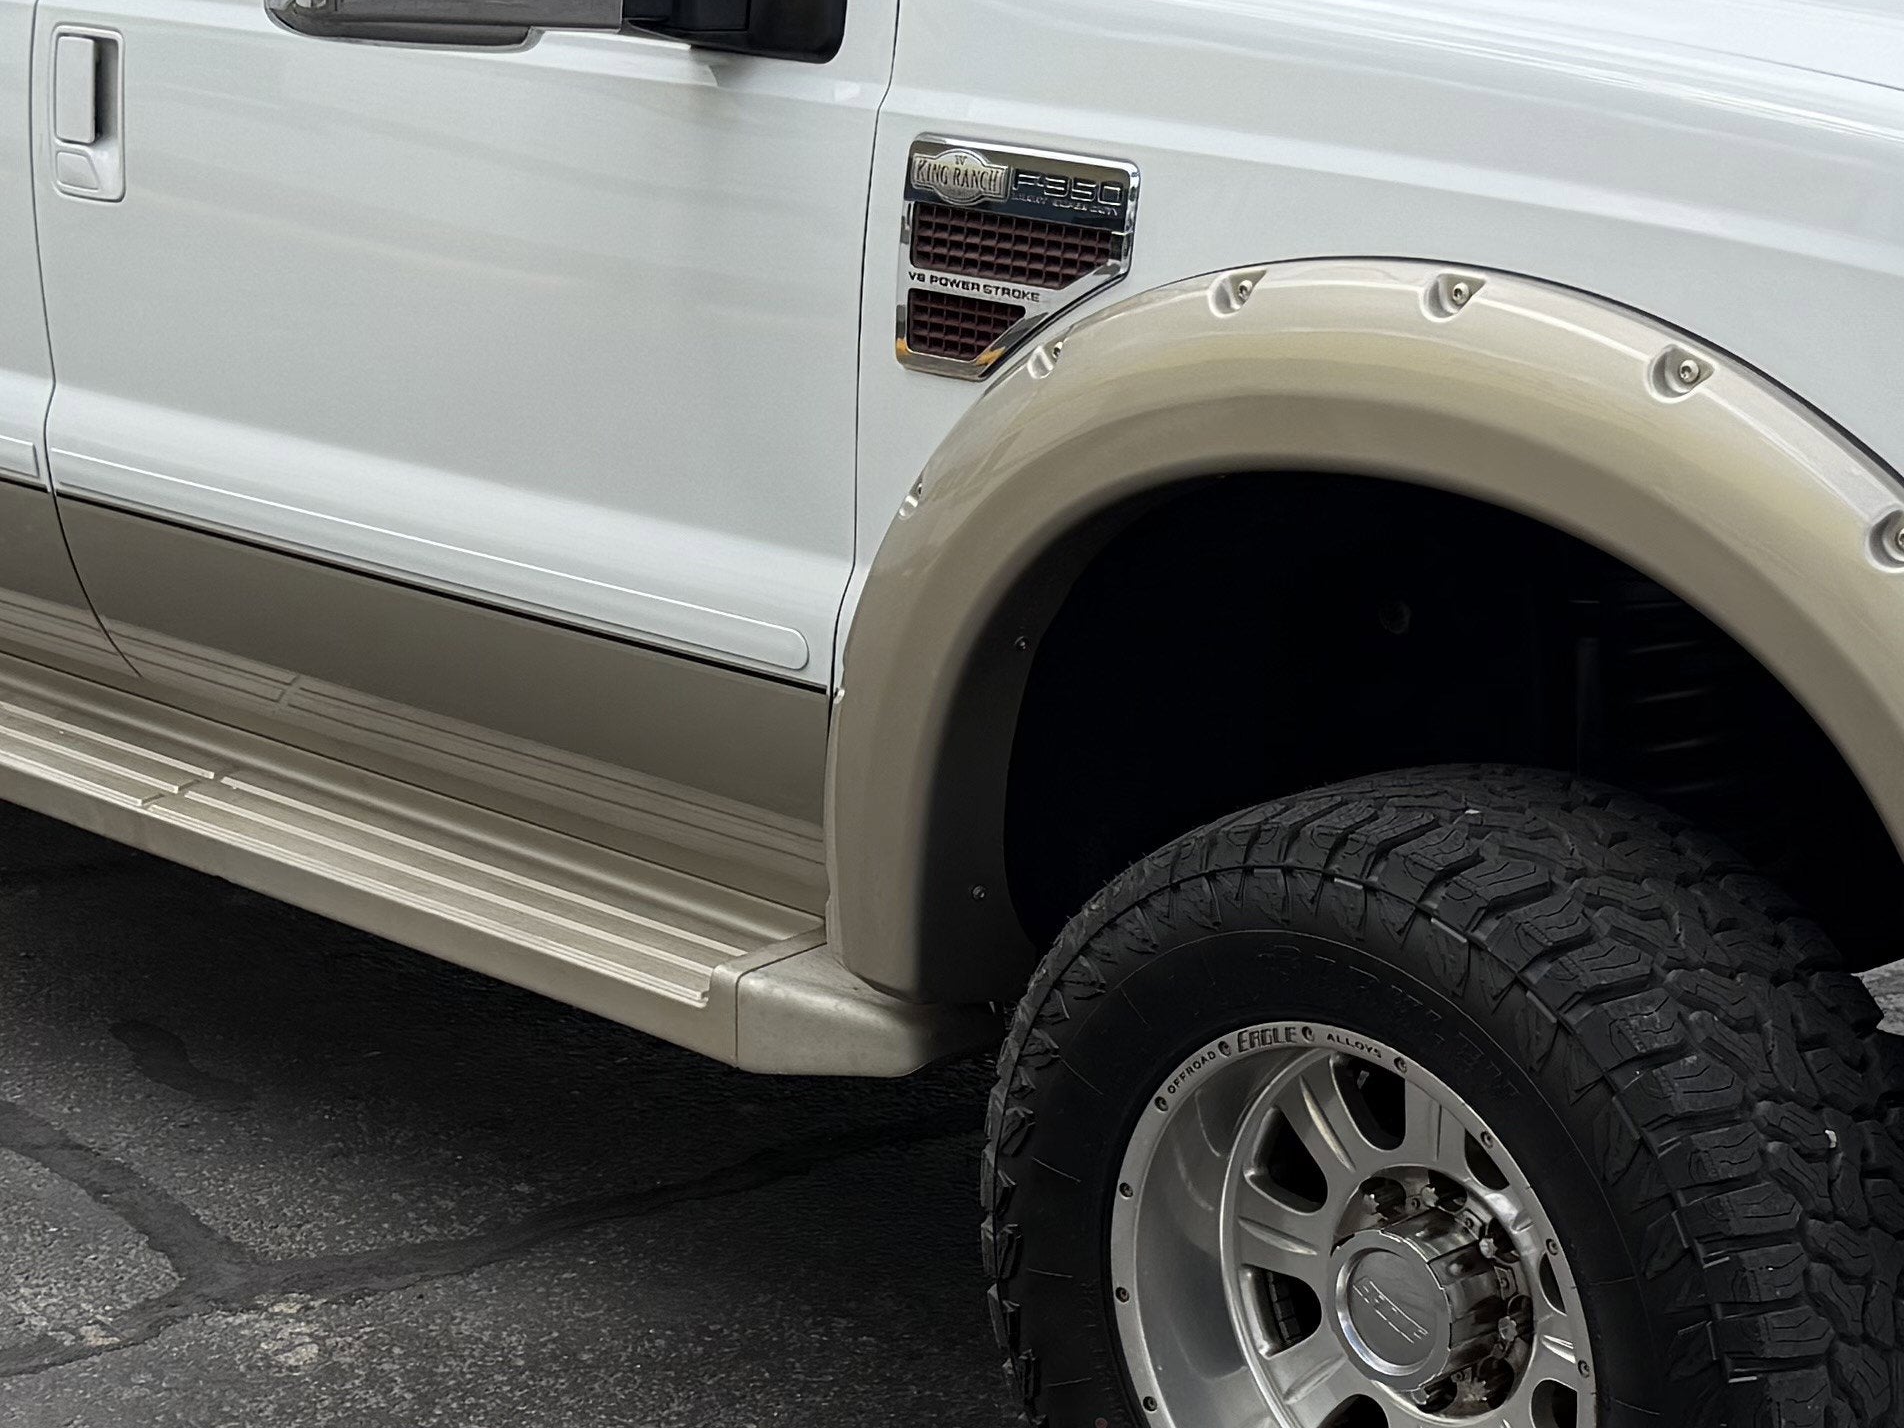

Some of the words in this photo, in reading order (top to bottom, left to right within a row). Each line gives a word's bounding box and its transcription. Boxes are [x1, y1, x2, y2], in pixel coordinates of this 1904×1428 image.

[916, 159, 949, 185] KING
[952, 167, 1000, 192] RANCH
[908, 271, 926, 282] V8
[929, 274, 980, 292] POWER
[982, 283, 1041, 303] STROKE
[1167, 1050, 1217, 1094] OFFROAD
[1237, 1026, 1296, 1053] EAGLE
[1326, 1033, 1382, 1059] ALLOYS
